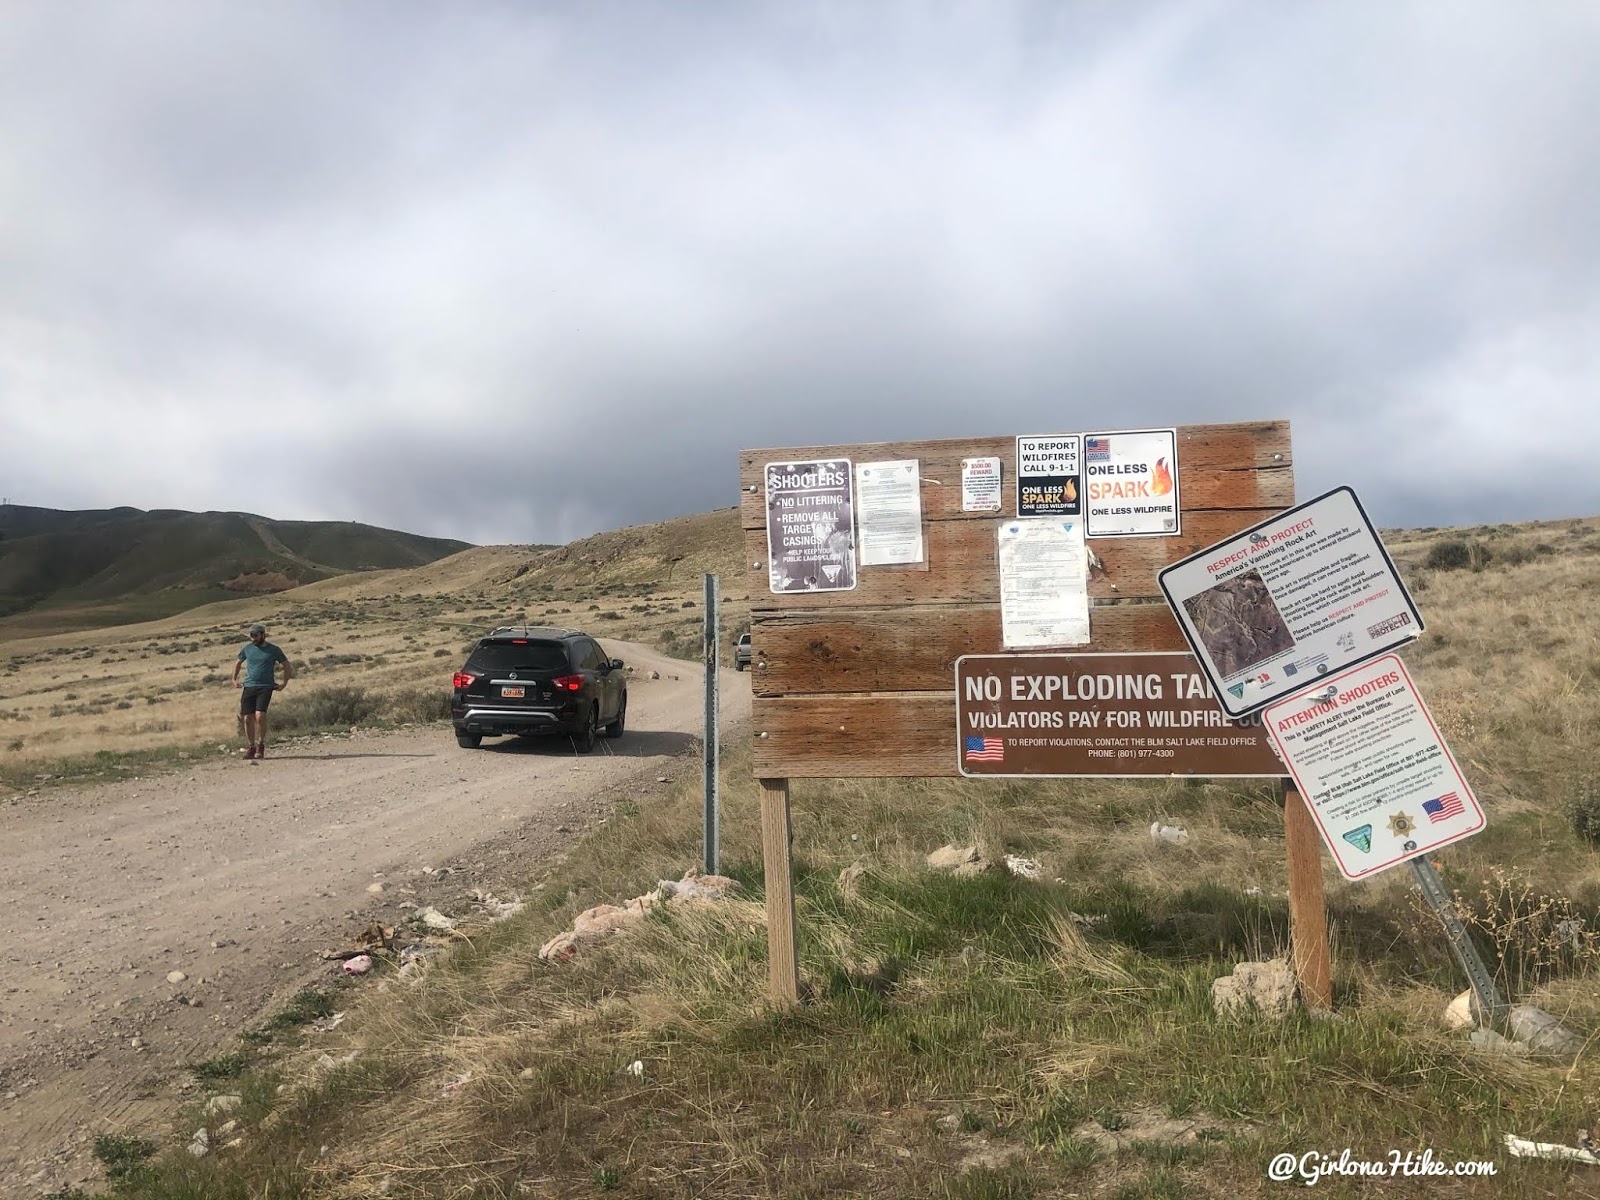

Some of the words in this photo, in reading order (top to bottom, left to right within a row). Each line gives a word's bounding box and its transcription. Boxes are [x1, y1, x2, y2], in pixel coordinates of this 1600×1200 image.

[1022, 453, 1076, 461] WILDFIRES
[1038, 442, 1075, 450] REPORT
[774, 472, 844, 488] SHOOTERS
[1089, 466, 1114, 475] ONE
[1117, 464, 1147, 473] LESS
[782, 498, 794, 506] NO
[797, 495, 842, 506] LITTERING
[1022, 494, 1061, 503] SPARK
[1089, 481, 1149, 499] SPARK
[782, 512, 820, 523] REMOVE
[822, 511, 839, 520] ALL
[783, 536, 822, 546] CASINGS
[1207, 549, 1247, 573] RESPECT
[1248, 538, 1271, 554] AND
[1271, 518, 1313, 543] PROTECT
[1262, 567, 1278, 576] Native
[1279, 555, 1305, 569] Americans
[1319, 539, 1337, 551] several
[1337, 528, 1361, 542] thousand
[1269, 558, 1281, 567] rock
[1305, 542, 1316, 550] area
[1327, 530, 1342, 539] made
[1215, 562, 1249, 581] America's
[1248, 545, 1285, 564] Vanishing
[1284, 535, 1304, 548] Rock
[1305, 529, 1317, 539] Art
[1266, 574, 1279, 584] years
[1271, 586, 1284, 594] Rock
[1298, 565, 1330, 582] irreplaceable
[1330, 560, 1340, 568] and
[1340, 553, 1358, 563] fragile.
[1274, 592, 1288, 600] Once
[1326, 567, 1341, 576] never
[1280, 603, 1294, 612] Rock
[1318, 586, 1331, 595] hard
[1350, 570, 1365, 580] Avoid
[1284, 606, 1306, 618] shooting
[1305, 596, 1326, 608] towards
[1326, 591, 1338, 599] rock
[1338, 585, 1351, 593] walls
[1352, 579, 1362, 587] and
[1361, 570, 1384, 582] boulders
[1315, 601, 1331, 611] which
[1331, 593, 1350, 604] contain
[1350, 587, 1362, 595] rock
[1292, 626, 1310, 636] Please
[1309, 620, 1321, 628] help
[1328, 606, 1352, 619] RESPECT
[1353, 600, 1365, 609] AND
[1364, 589, 1389, 603] PROTECT
[1295, 632, 1312, 641] Native
[1312, 621, 1336, 634] American
[1336, 613, 1354, 623] culture.
[1369, 619, 1405, 640] PROTECT
[965, 676, 1001, 700] NO
[1011, 674, 1162, 700] EXPLODING
[1278, 698, 1338, 732] ATTENTION
[1339, 671, 1399, 704] SHOOTERS
[1284, 734, 1296, 742] This
[1305, 720, 1325, 733] SAFETY
[1326, 713, 1342, 724] ALERT
[1342, 708, 1356, 716] from
[1365, 696, 1385, 707] Bureau
[1391, 686, 1405, 696] Land
[968, 712, 1063, 728] VIOLATORS
[1069, 712, 1100, 728] PAY
[1107, 711, 1141, 727] FOR
[1147, 710, 1232, 728] WILDFIRE
[1303, 724, 1337, 742] Management
[1337, 719, 1348, 728] Salt
[1348, 714, 1361, 723] Lake
[1361, 707, 1375, 717] Field
[1375, 701, 1392, 711] Office.
[1020, 738, 1047, 746] REPORT
[1049, 738, 1093, 747] VIOLATIONS,
[1095, 738, 1129, 746] CONTACT
[1131, 738, 1145, 746] THE
[1148, 738, 1163, 746] BLM
[1230, 737, 1257, 745] OFFICE
[1088, 750, 1116, 758] PHONE:
[1118, 750, 1136, 759] (801)
[1138, 749, 1174, 758] 977-4300
[1313, 789, 1330, 800] Contact
[1330, 785, 1341, 793] BLM
[1373, 766, 1386, 774] Field
[1385, 761, 1400, 769] Office
[1405, 744, 1438, 761] 801-977-4300
